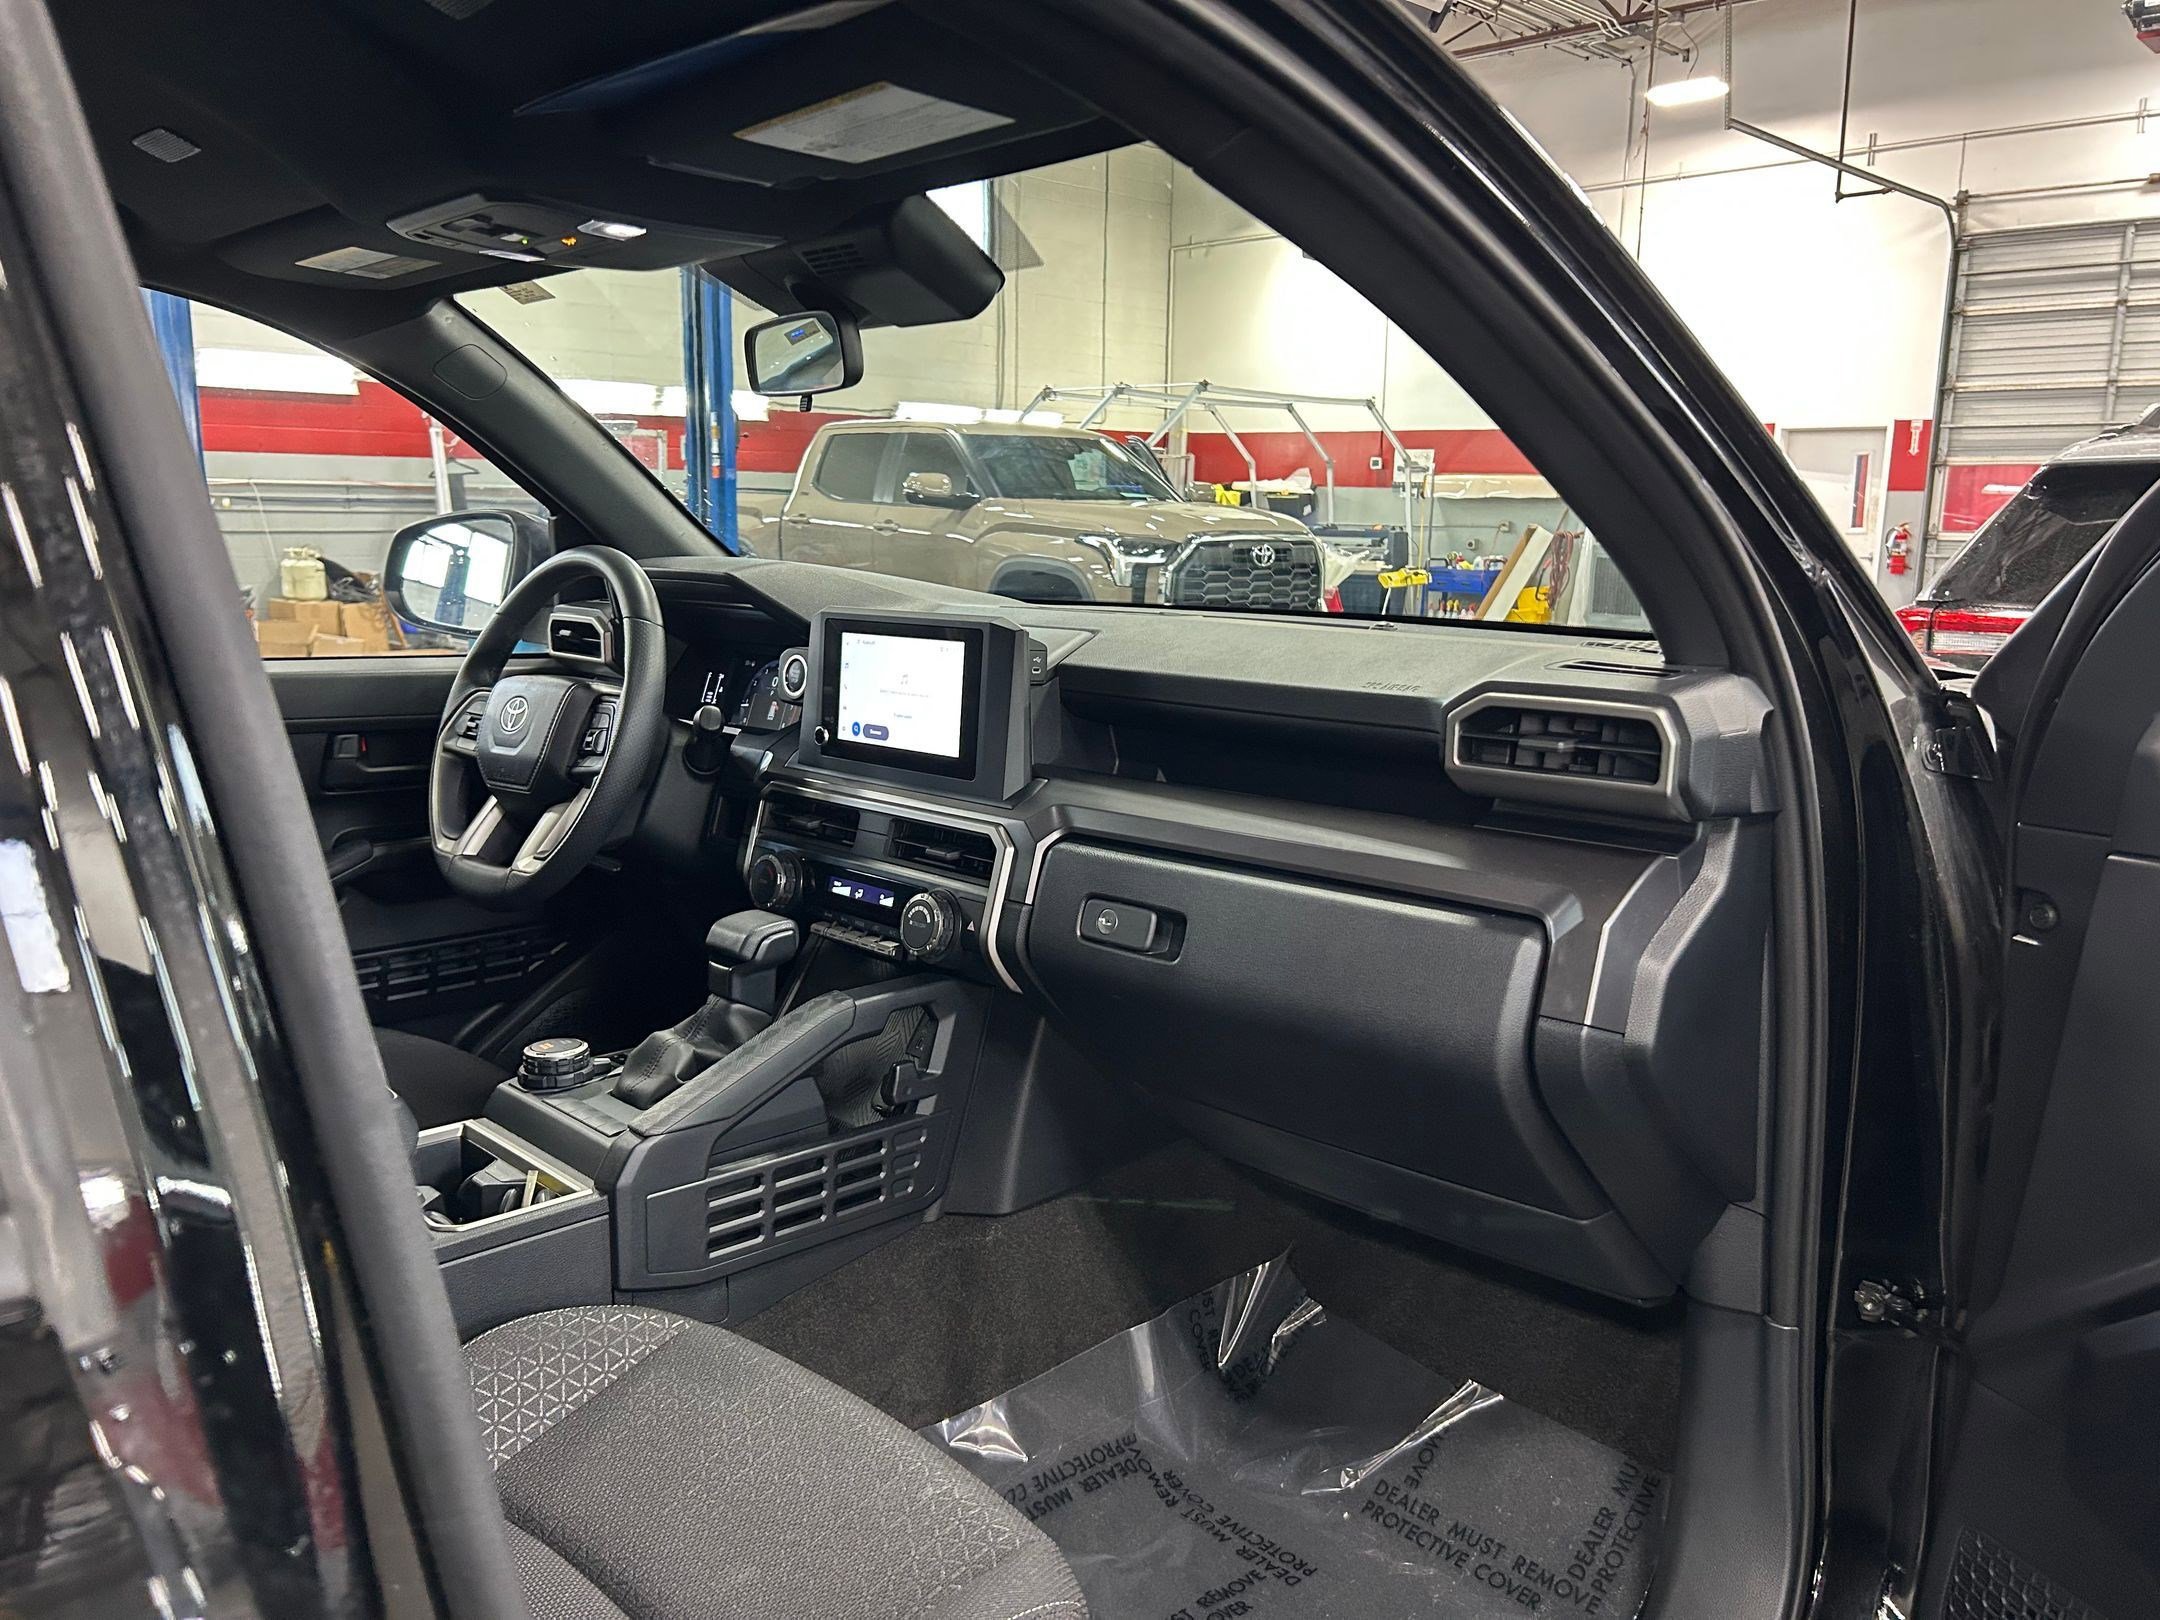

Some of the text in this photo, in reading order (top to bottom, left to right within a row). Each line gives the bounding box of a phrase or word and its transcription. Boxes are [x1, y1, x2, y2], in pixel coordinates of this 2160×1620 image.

[1025, 1458, 1138, 1521] DEALER MUST
[1031, 1438, 1126, 1493] PROTECTIVE
[1163, 1469, 1319, 1578] PROTECTIVE COVER
[1180, 1508, 1232, 1544] MUST
[1361, 1499, 1542, 1610] PROTECTIVE COVER
[1373, 1478, 1603, 1616] DEALER MUST REMOVE
[1567, 1505, 1617, 1582] DEALER
[1590, 1473, 1661, 1594] PROTECTIVE
[1197, 1568, 1267, 1609] REMOVE
[1235, 1545, 1302, 1587] DEALER
